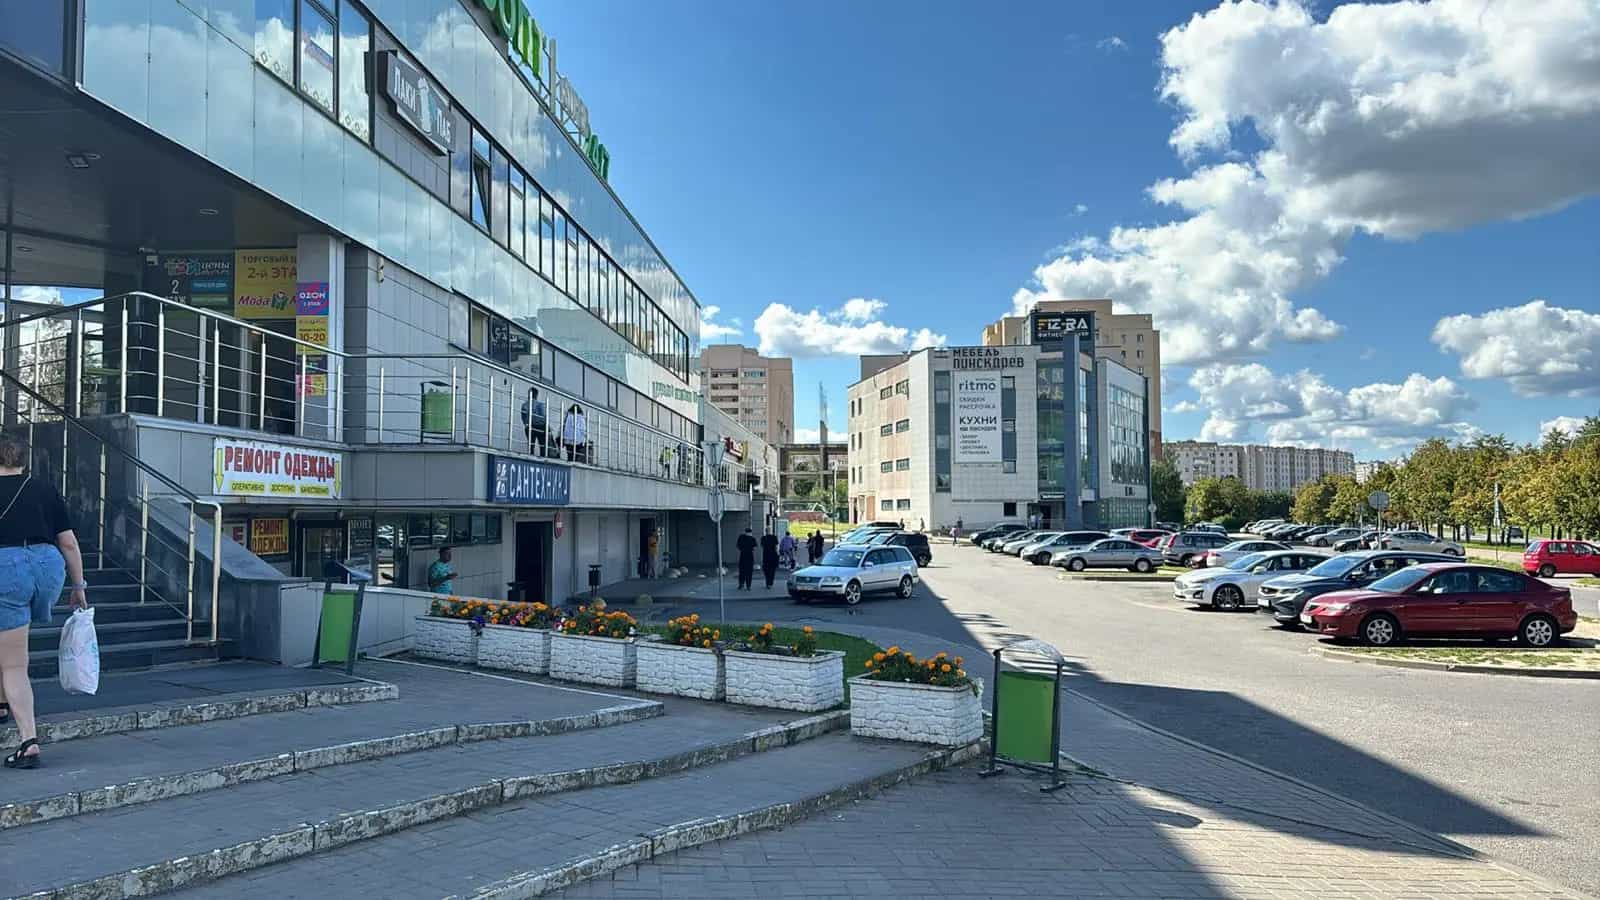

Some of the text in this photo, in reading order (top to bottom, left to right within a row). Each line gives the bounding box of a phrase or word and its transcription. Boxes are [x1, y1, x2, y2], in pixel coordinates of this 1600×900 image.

[271, 266, 297, 279] ЭТА
[171, 279, 180, 294] 2
[952, 348, 1000, 357] МЕБЕЛЬ
[959, 380, 996, 391] ritmo
[959, 415, 997, 424] КУХНИ
[224, 446, 335, 482] РЕМОНТ ОДЕЖДЫ
[254, 519, 284, 535] РЕМОНТ
